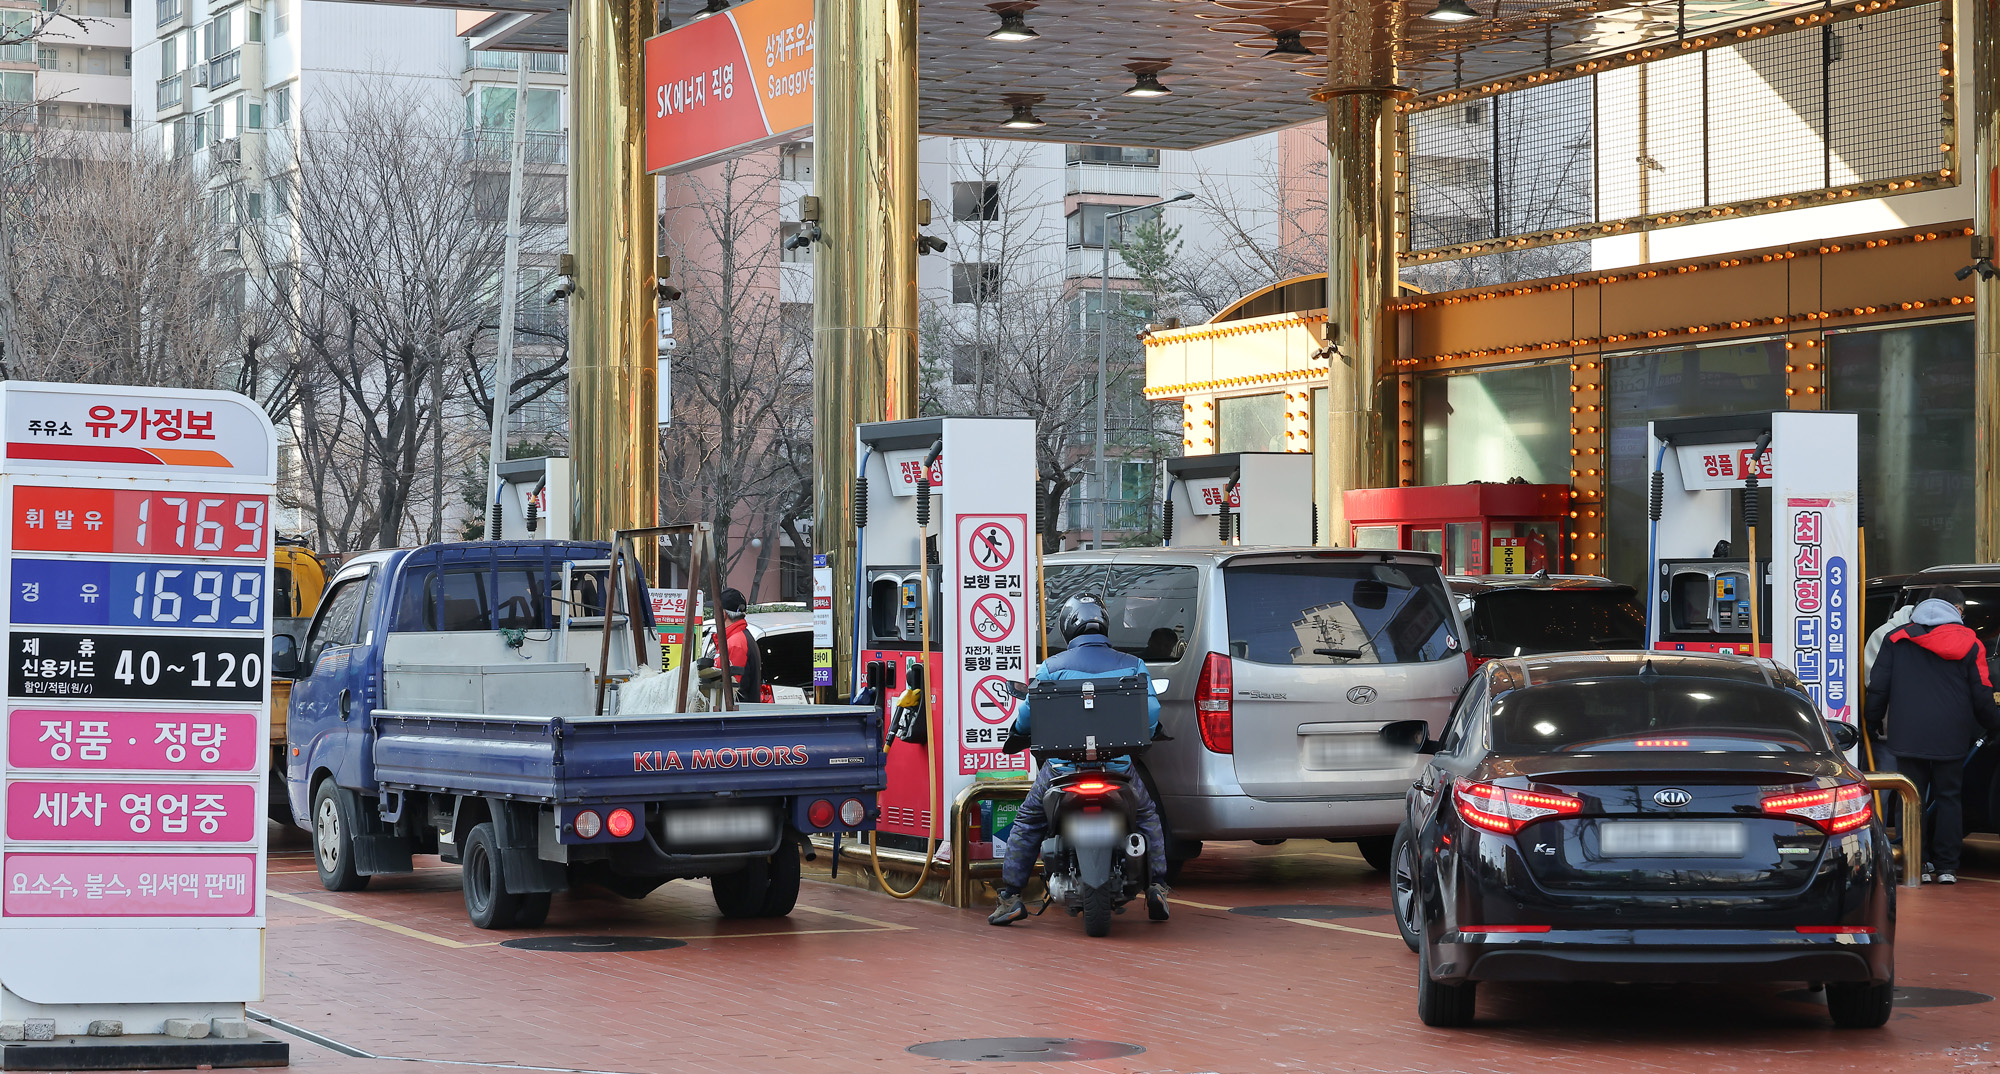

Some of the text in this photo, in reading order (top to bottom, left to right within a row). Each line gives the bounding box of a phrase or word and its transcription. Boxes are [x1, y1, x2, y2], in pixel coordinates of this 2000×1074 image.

[656, 62, 734, 118] SK에너지 직영
[28, 405, 216, 441] 주유소 유가정보
[900, 459, 943, 484] 정품 정
[1703, 453, 1734, 477] 정품
[1201, 485, 1241, 506] 정품 정
[136, 496, 266, 552] 1769
[1794, 511, 1822, 612] 최신형
[963, 574, 1021, 589] 보행 금지
[132, 569, 262, 624] 1699
[651, 598, 699, 613] 불스원
[661, 645, 671, 672] 주유
[965, 646, 993, 656] 자전거,
[21, 658, 96, 678] 신용카드
[965, 656, 1022, 671] 통행 금지
[1828, 659, 1845, 700] 가동
[38, 720, 112, 761] 정품
[154, 722, 227, 764] 정량
[966, 728, 1009, 743] 흡연 금
[633, 744, 809, 772] KIA MOTORS
[963, 752, 1026, 769] 화기엄금
[996, 804, 1020, 812] AdBlu
[1660, 792, 1686, 804] KIA
[33, 792, 228, 834] 세차 영업중
[1533, 843, 1556, 856] K5
[9, 872, 246, 899] 요소수, 불스, 워셔액 판매
